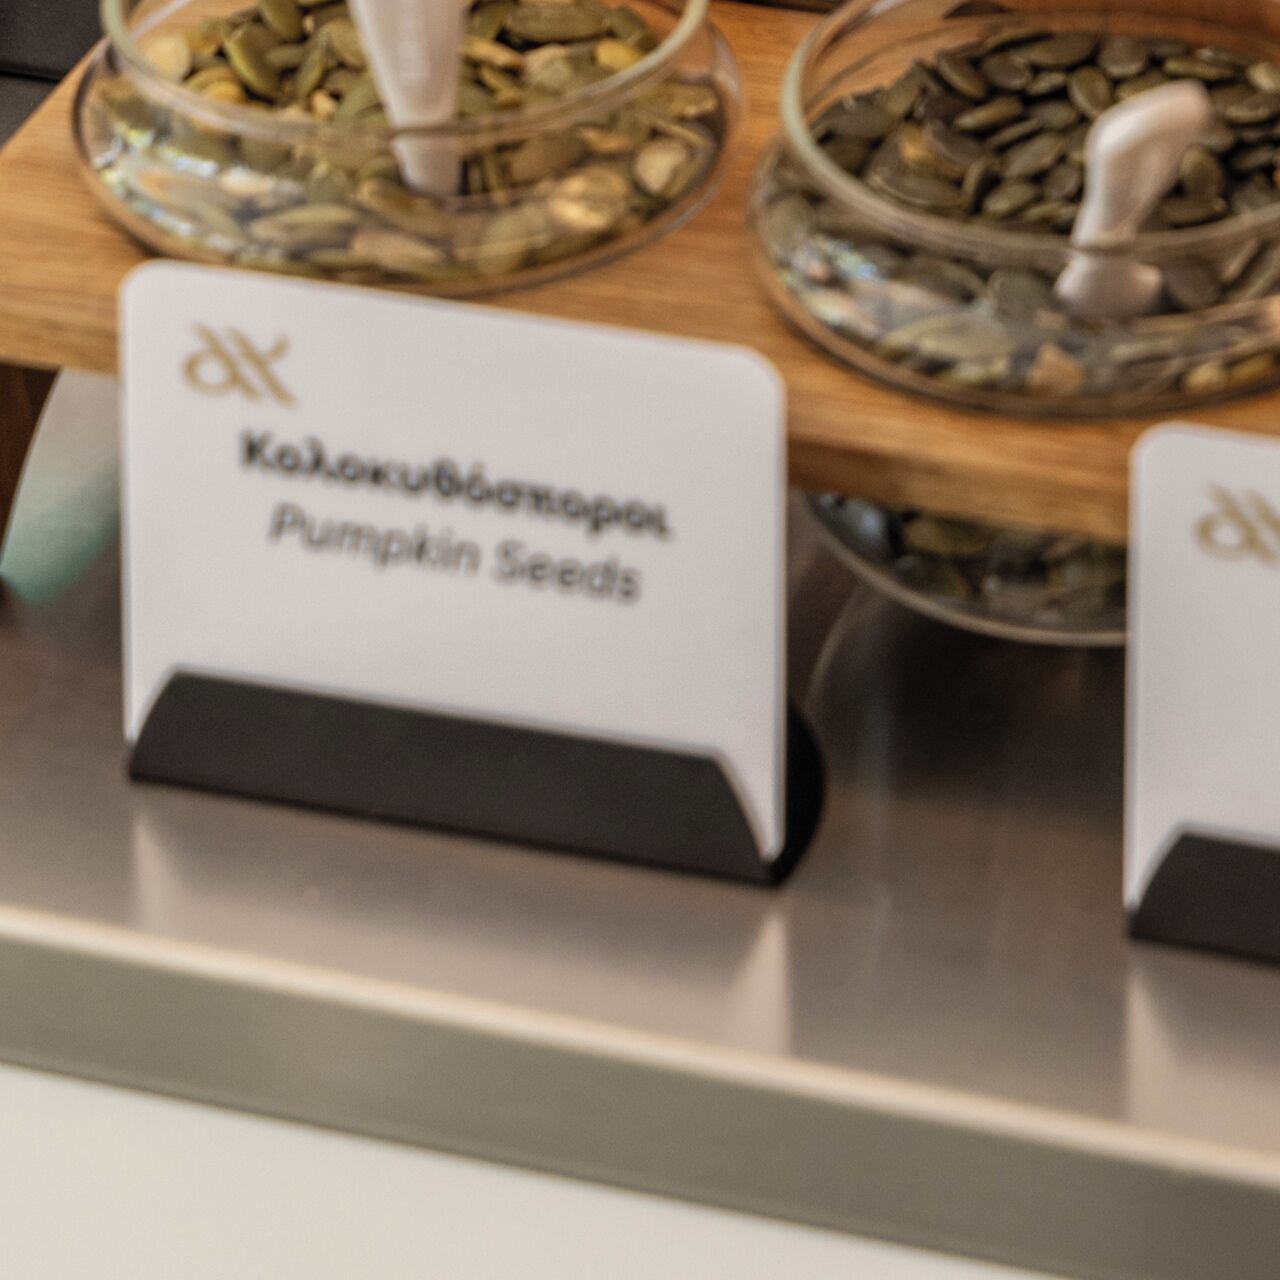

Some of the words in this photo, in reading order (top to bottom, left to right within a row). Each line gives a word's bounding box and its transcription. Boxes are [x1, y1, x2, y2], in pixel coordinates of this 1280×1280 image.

[239, 428, 674, 542] Κολοκυθόσποροι
[267, 501, 481, 573] Pumpkin
[492, 537, 643, 606] Seeds
